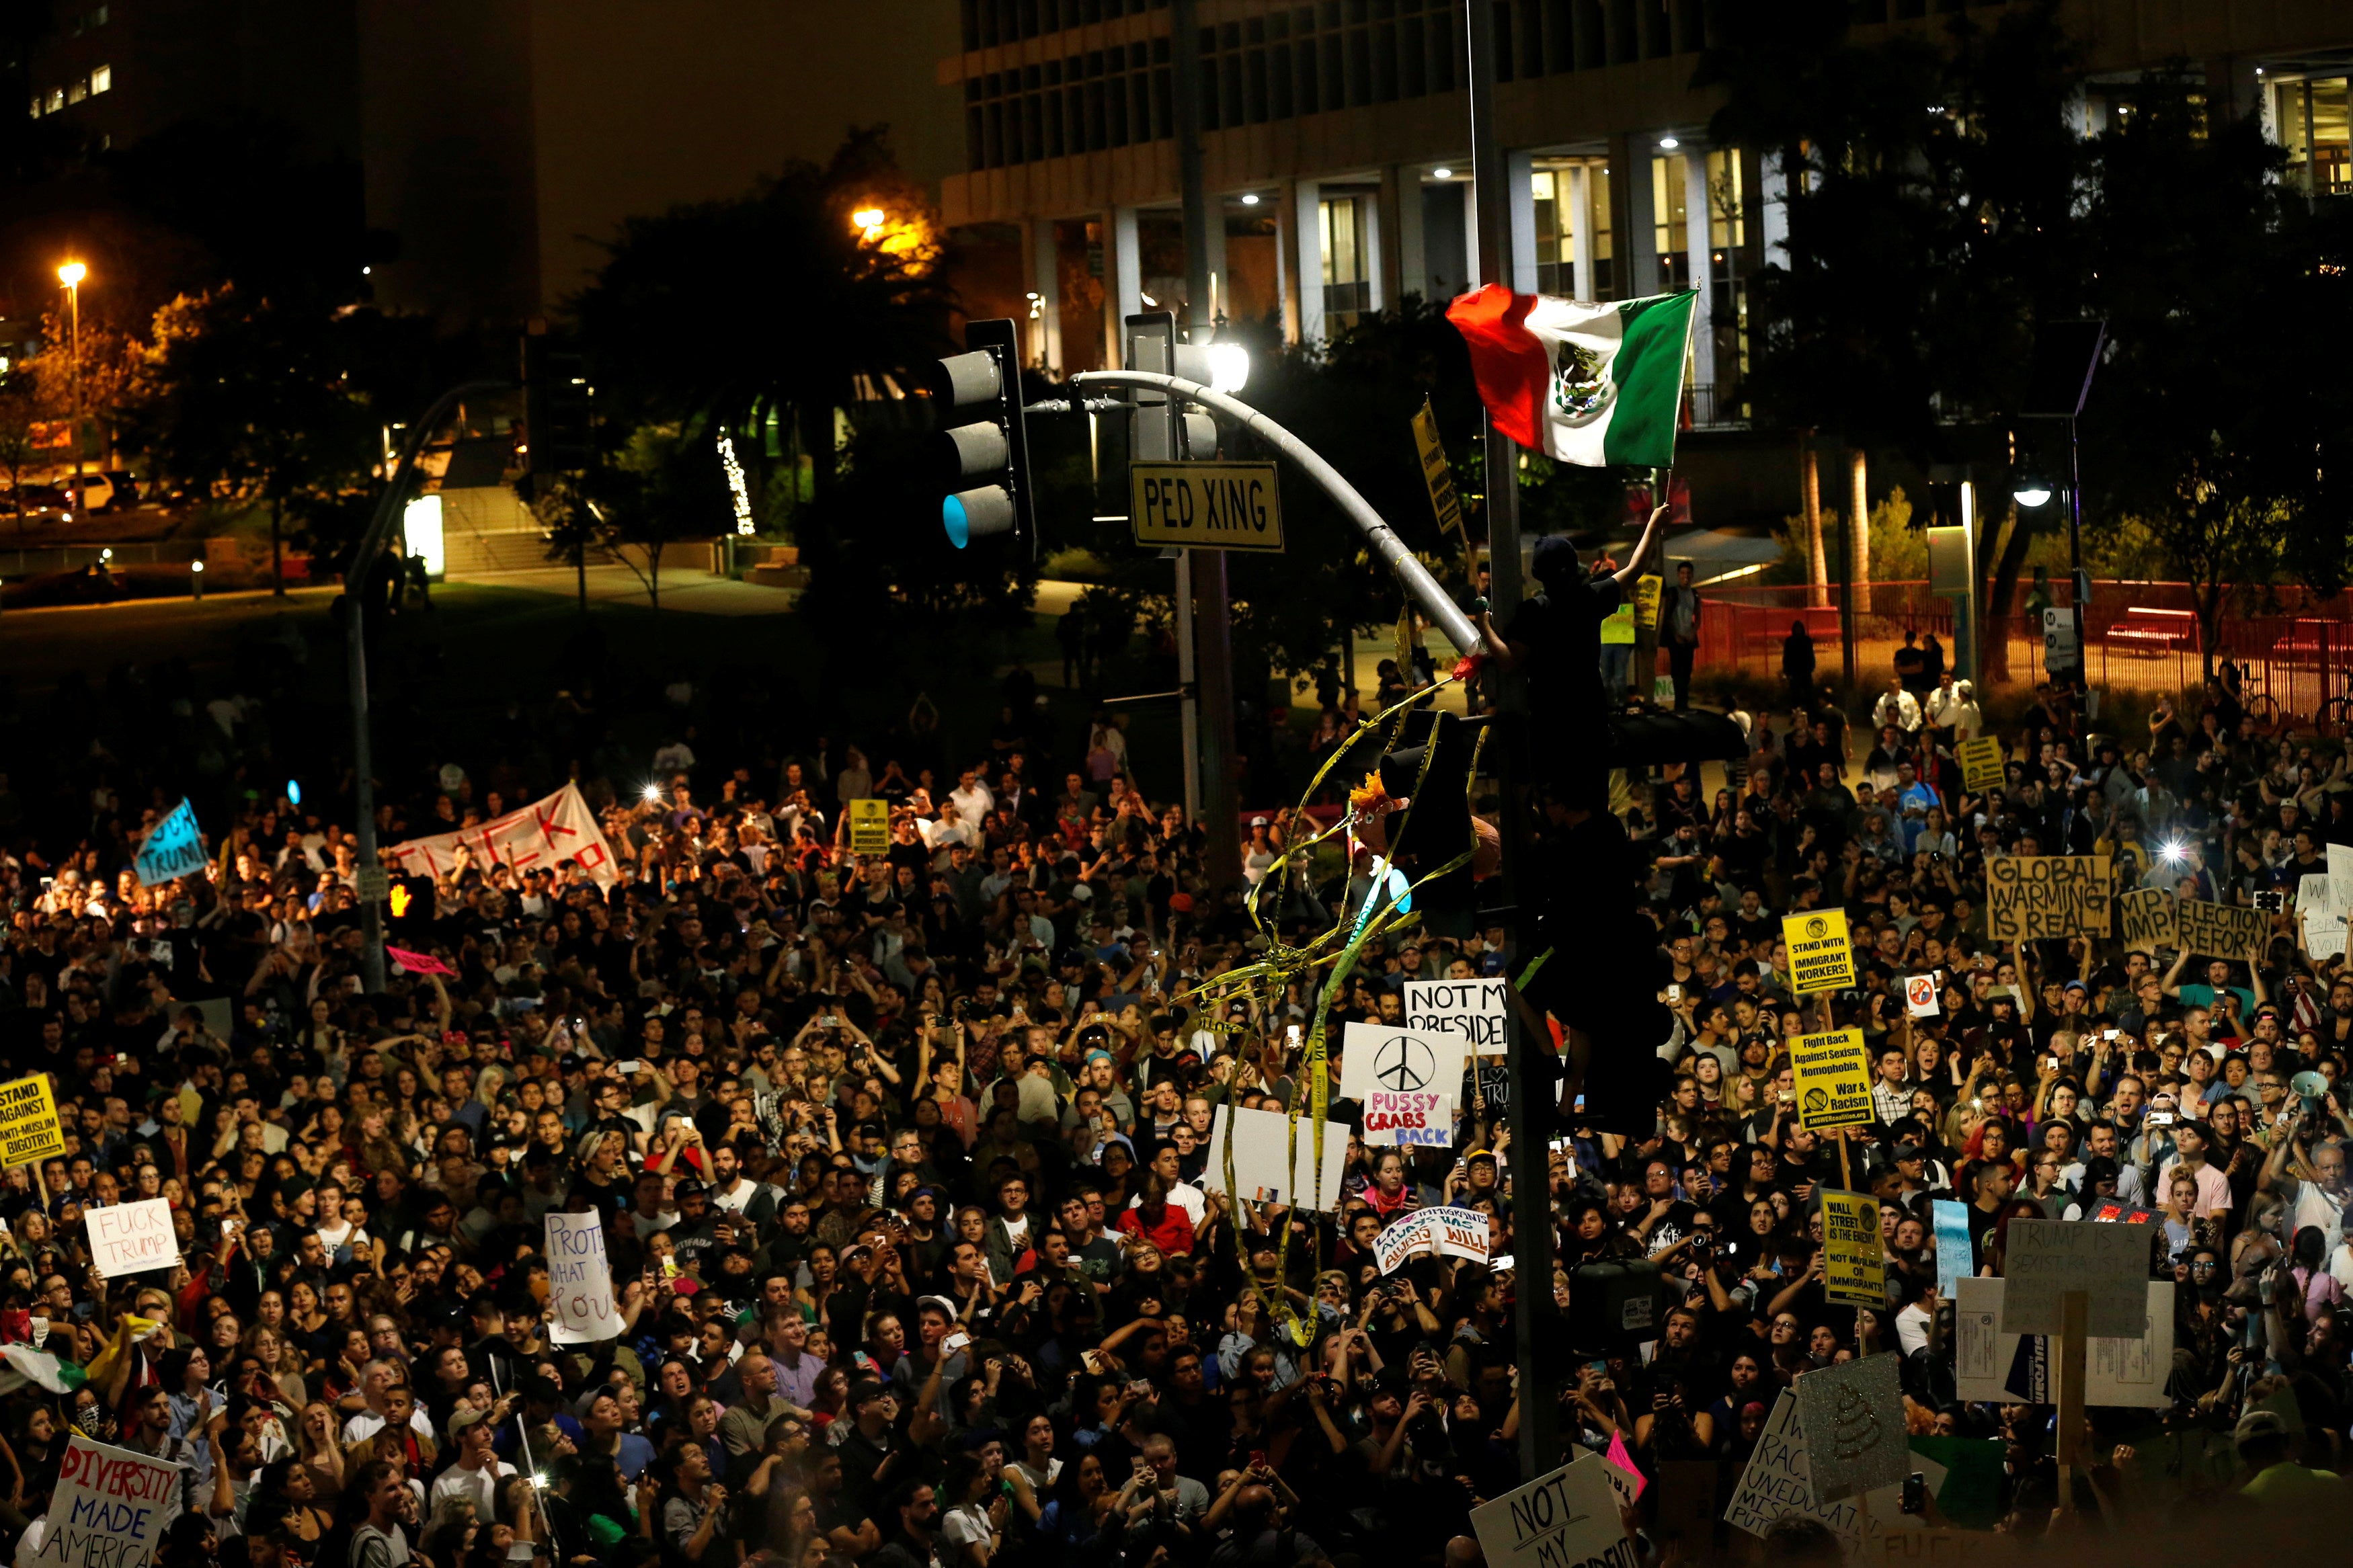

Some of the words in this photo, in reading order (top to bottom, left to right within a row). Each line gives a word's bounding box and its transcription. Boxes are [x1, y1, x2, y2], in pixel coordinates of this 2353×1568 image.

[1144, 478, 1194, 528] PED
[1202, 479, 1267, 533] XING
[1993, 858, 2107, 884] GLOBAL
[1989, 882, 2108, 914] WARMING
[1992, 907, 2020, 936] IS
[2178, 899, 2268, 934] ELECTION
[1792, 941, 1821, 954] STAND
[1821, 937, 1845, 949] WITH
[2178, 921, 2266, 961] REFORM
[1794, 952, 1846, 969] IMMIGRANT
[1796, 963, 1848, 981] WORKERS!
[1412, 985, 1477, 1012] NOT
[1803, 1037, 1825, 1049] Fight
[1827, 1033, 1849, 1046] Back
[1794, 1051, 1827, 1065] Against
[1828, 1047, 1863, 1061] Sexism,
[1800, 1061, 1861, 1078] Homophobia,
[0, 1082, 40, 1107] STAND
[1835, 1082, 1858, 1096] War
[1858, 1081, 1867, 1093] &
[0, 1097, 46, 1124] AGAINST
[1372, 1092, 1440, 1112] PUSSY
[1830, 1096, 1869, 1111] Racism
[0, 1116, 56, 1142] ANTI-MUSLIM
[1365, 1112, 1427, 1132] GRABS
[1808, 1111, 1866, 1126] ANSWERcoalition.org
[6, 1130, 56, 1155] BIGOTRY!
[1395, 1128, 1448, 1146] BACK
[1827, 1201, 1852, 1215] WALL
[99, 1207, 165, 1239] FUCK
[1376, 1227, 1396, 1246] LA
[1419, 1208, 1488, 1225] IMMIGRANTS
[1829, 1214, 1859, 1229] STREET
[1381, 1216, 1436, 1256] ALWAYS
[1439, 1216, 1474, 1230] HAS
[1385, 1225, 1431, 1268] ALWAYS
[1445, 1219, 1488, 1251] WILL
[1829, 1227, 1838, 1240] IS
[1839, 1229, 1853, 1242] THE
[2012, 1223, 2084, 1251] TRUMP
[2094, 1228, 2112, 1251] IS
[2124, 1227, 2139, 1250] A
[102, 1233, 167, 1264] TRUMP
[686, 1249, 696, 1258] LA
[550, 1261, 586, 1284] WHAT
[1829, 1253, 1847, 1264] NOT
[1849, 1255, 1882, 1270] MUSLIMS
[1853, 1266, 1864, 1277] OR
[1829, 1275, 1882, 1292] IMMIGRANTS
[60, 1445, 177, 1505] DIVERSITY
[70, 1494, 152, 1540] MADE
[1510, 1473, 1570, 1540] NOT
[38, 1525, 151, 1568] AMERICA
[1537, 1528, 1568, 1568] MY
